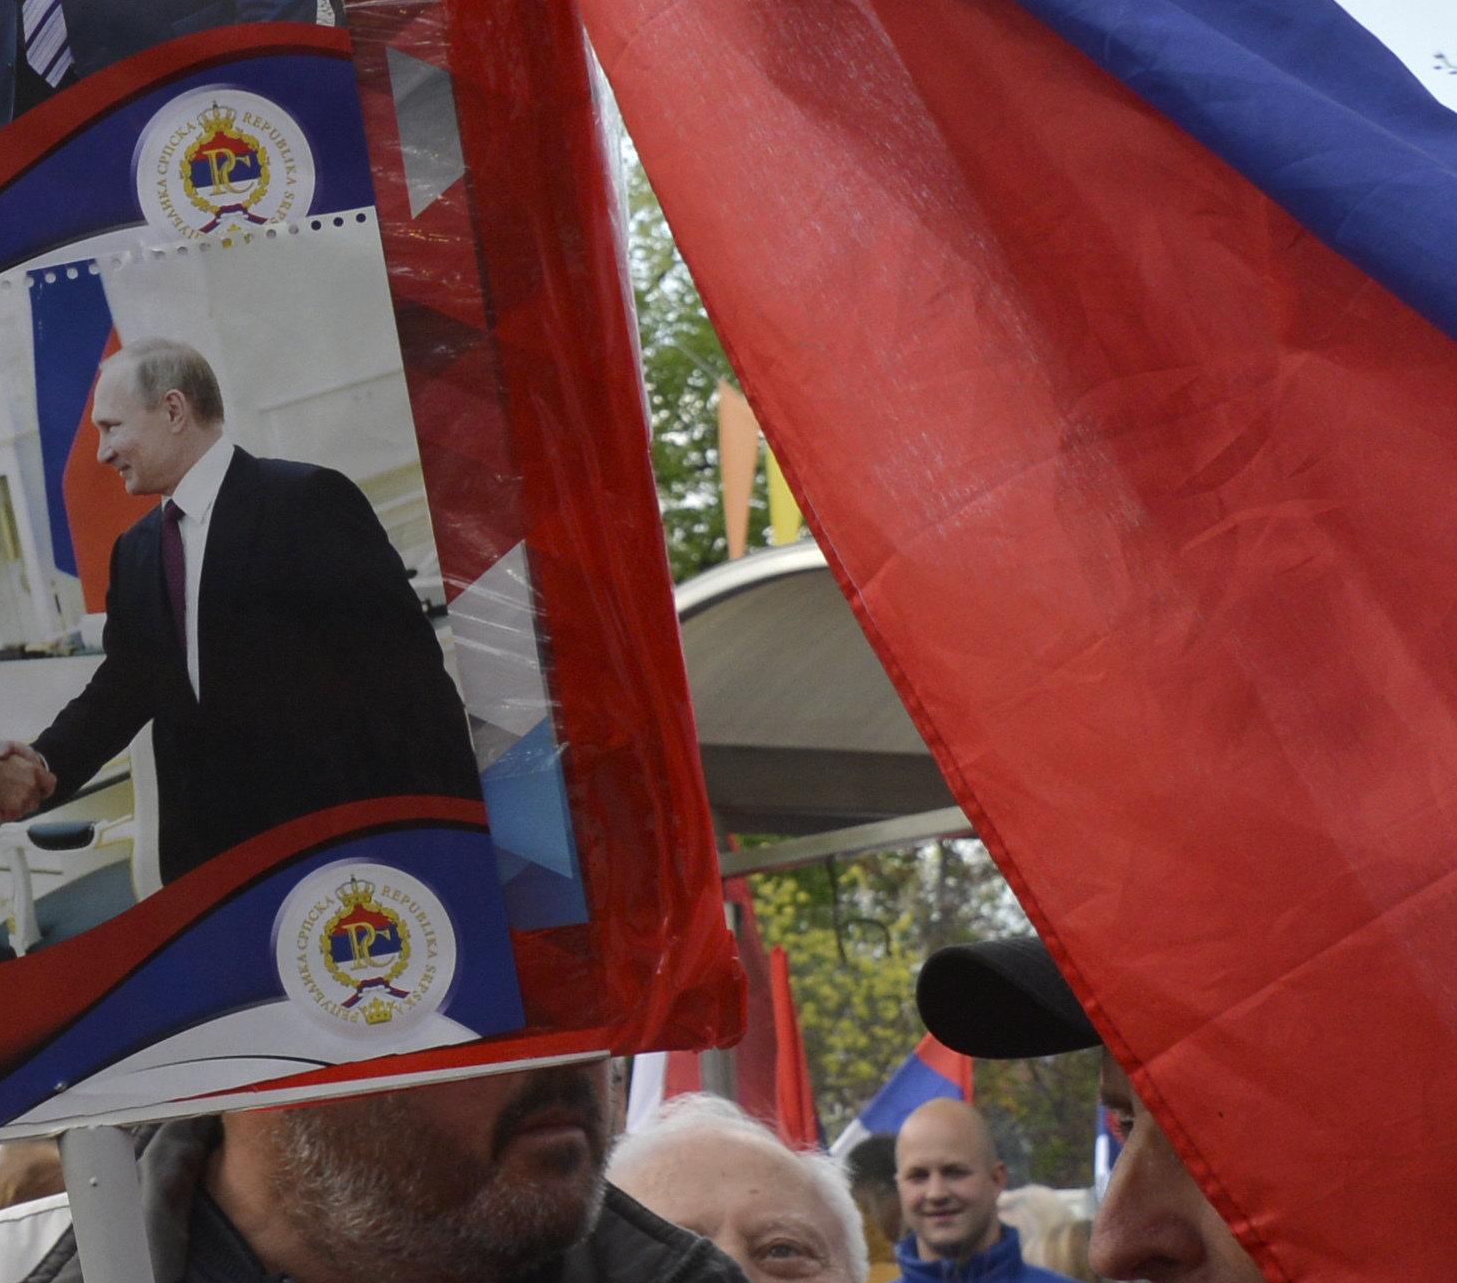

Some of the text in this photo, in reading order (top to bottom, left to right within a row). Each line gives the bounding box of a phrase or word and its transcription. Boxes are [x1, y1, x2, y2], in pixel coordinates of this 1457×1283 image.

[242, 111, 298, 225] REPUBLIKA SRPS
[381, 885, 438, 958] REPUBLIKA
